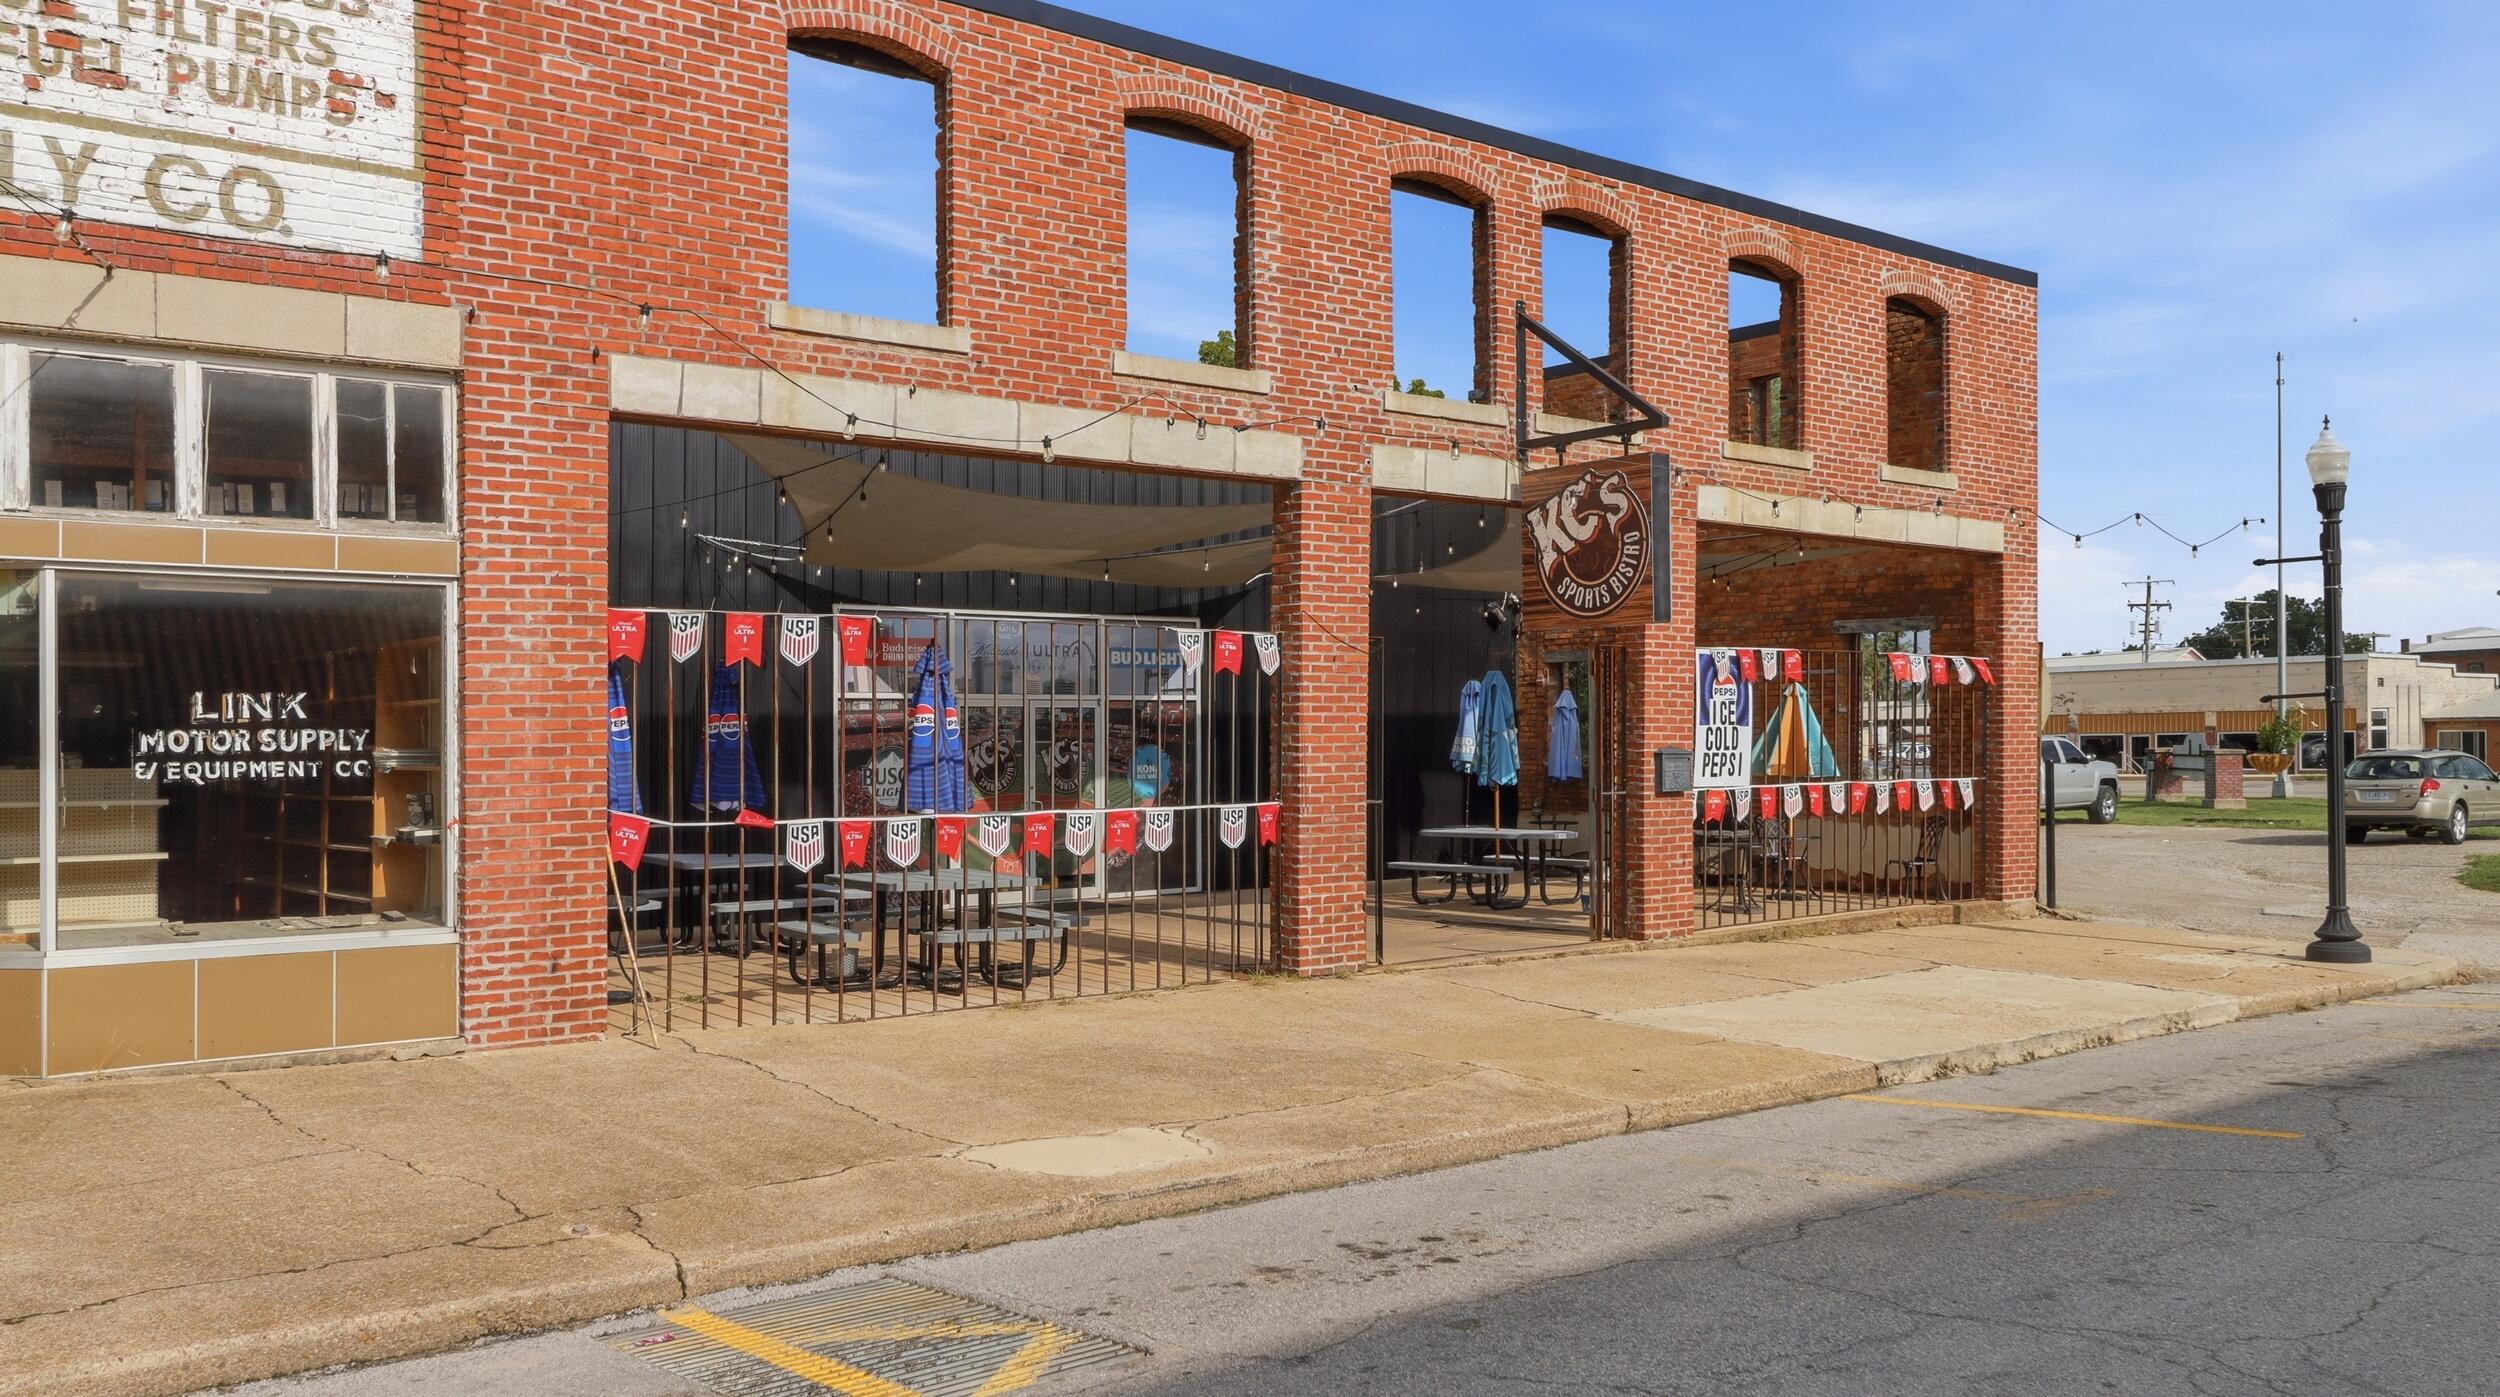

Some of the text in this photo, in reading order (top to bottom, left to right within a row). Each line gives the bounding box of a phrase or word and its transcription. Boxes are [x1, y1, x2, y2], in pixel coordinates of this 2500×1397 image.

[167, 53, 357, 127] PUMPS
[1557, 531, 1641, 609] SPORTS BISTRO
[786, 619, 814, 637] USA
[1180, 634, 1199, 649] USA
[1258, 636, 1274, 651] USA
[1033, 644, 1081, 658] ULTRA
[1111, 651, 1142, 665] BUD
[1713, 687, 1736, 696] PEPSI
[191, 691, 308, 722] LINK
[1712, 700, 1736, 726] ICE
[138, 728, 371, 754] MOTOR SUPPLY
[1705, 726, 1739, 751] COLD
[164, 760, 322, 784] EQUIPMENT
[1136, 765, 1157, 774] KON
[1702, 752, 1742, 778] PEPSI
[984, 816, 1007, 830] USA
[1069, 815, 1092, 832] USA
[1149, 813, 1170, 829] USA
[1223, 809, 1244, 825] USA
[615, 830, 639, 840] ULTRA
[791, 825, 819, 843] USA
[892, 822, 917, 840] USA
